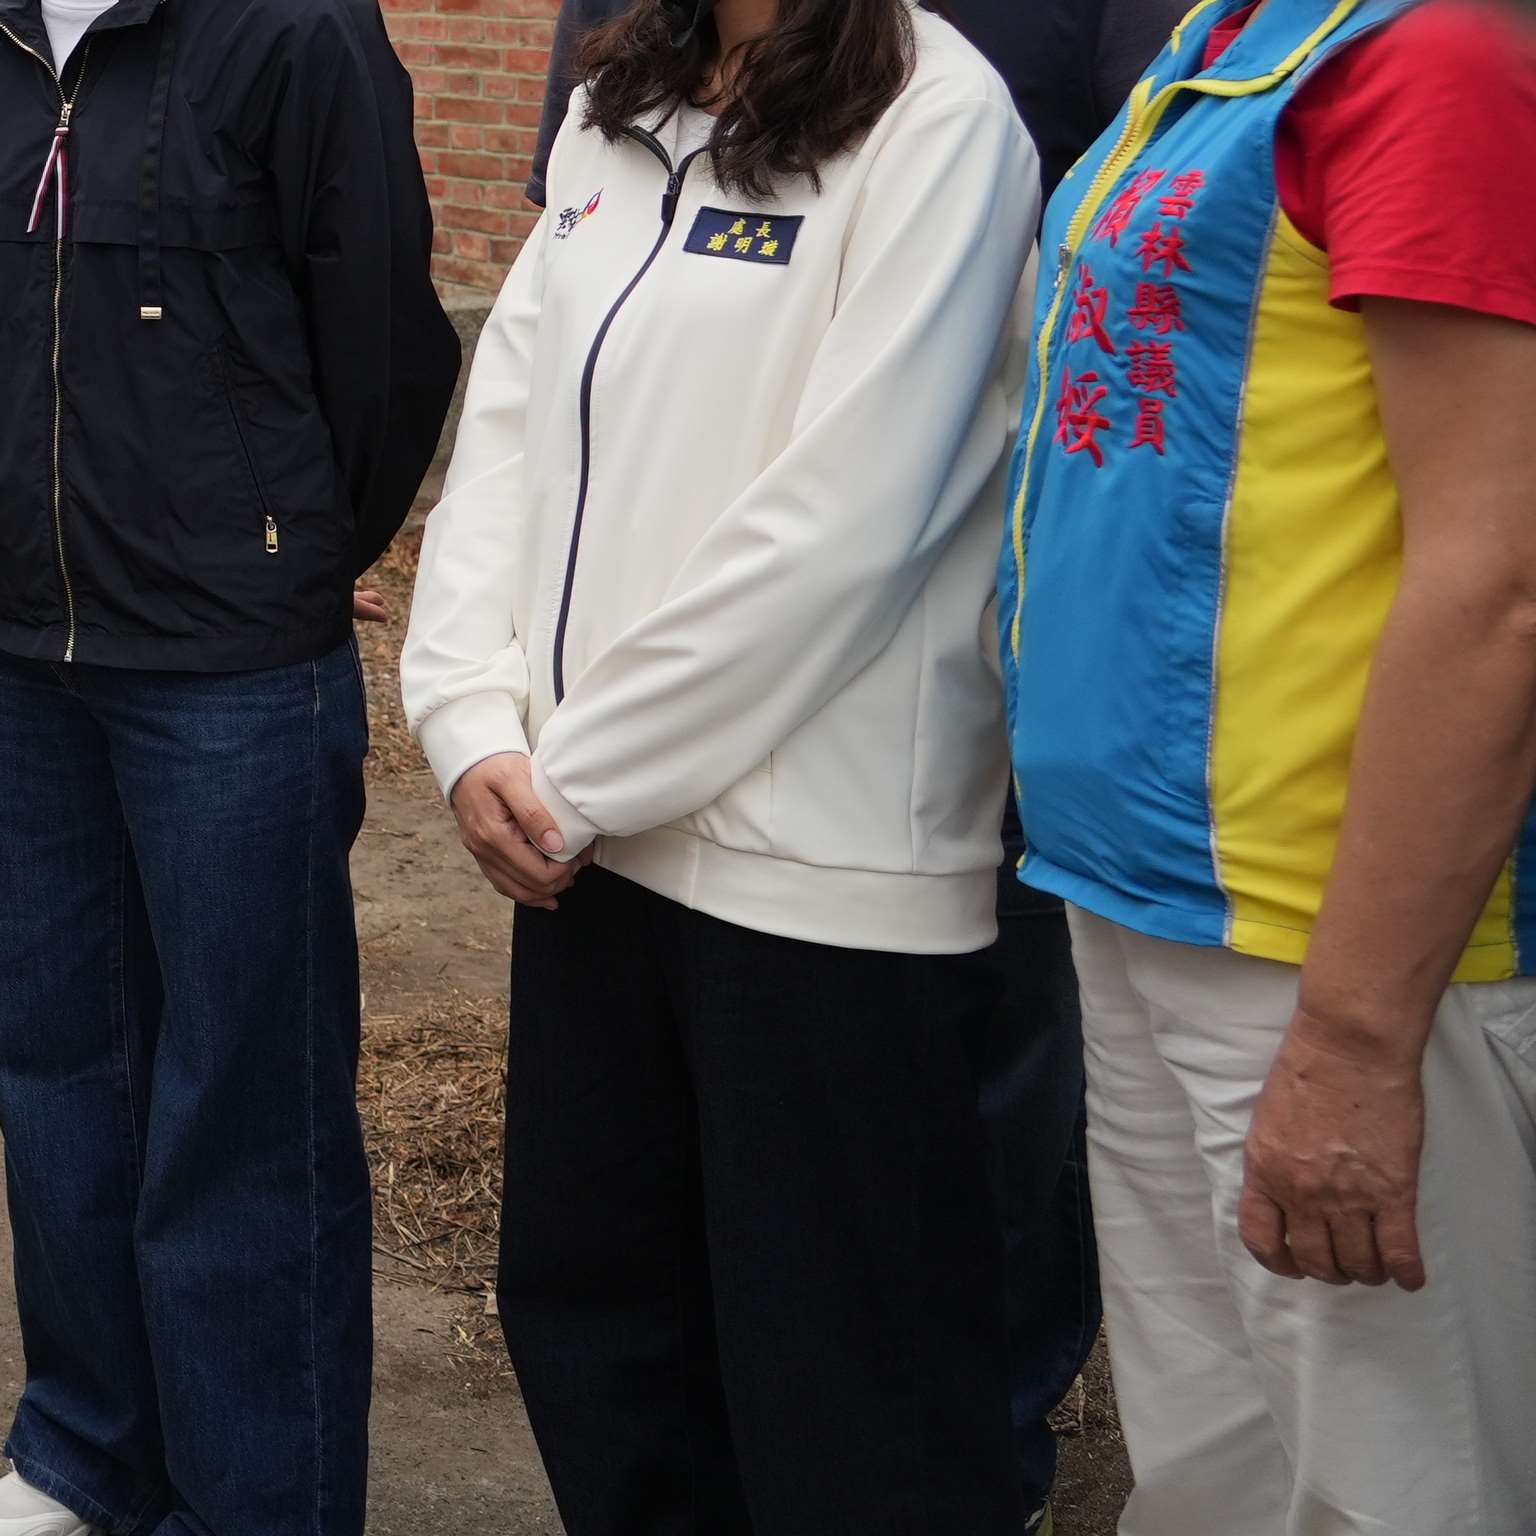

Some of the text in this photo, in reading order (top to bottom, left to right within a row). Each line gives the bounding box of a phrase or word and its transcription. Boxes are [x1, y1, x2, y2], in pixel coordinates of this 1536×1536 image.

[1126, 169, 1206, 455] 雲林縣議員
